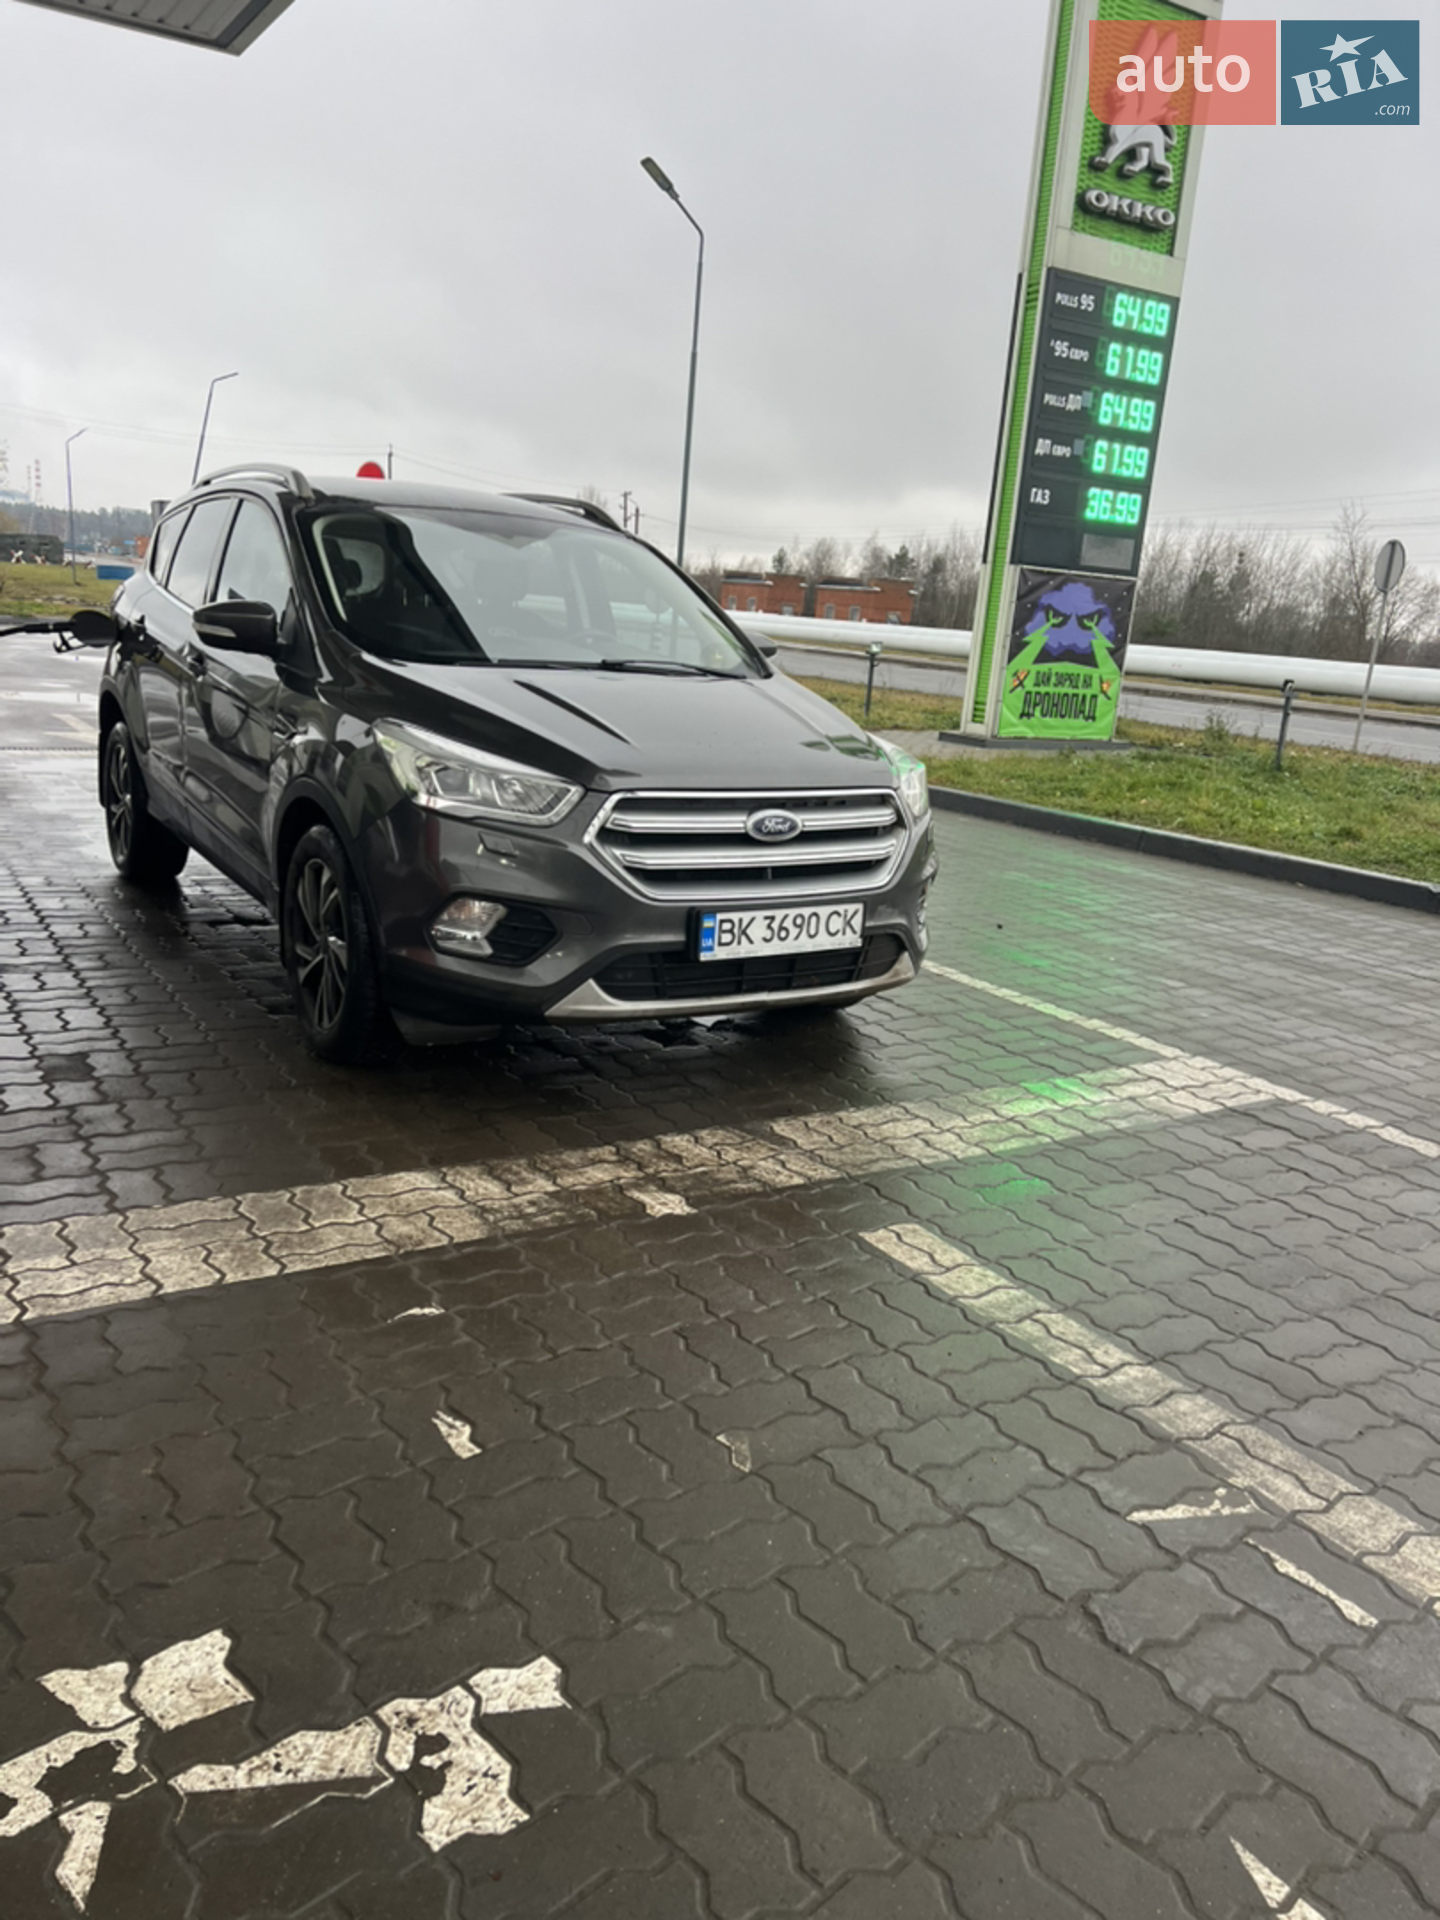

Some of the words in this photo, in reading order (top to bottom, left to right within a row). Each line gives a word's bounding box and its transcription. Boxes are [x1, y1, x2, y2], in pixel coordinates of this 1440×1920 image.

[1083, 188, 1175, 228] OKKO
[1079, 293, 1095, 312] 95
[1112, 292, 1170, 338] 64.99
[1105, 341, 1163, 385] 61.99
[1098, 391, 1156, 433] 64.99
[1034, 438, 1052, 457] ДП
[1091, 439, 1149, 479] 61.99
[1030, 487, 1051, 505] ГАЗ
[1084, 486, 1142, 525] 36.99
[1033, 668, 1053, 687] ДАЙ
[1053, 671, 1080, 690] ЗАРЯД
[1081, 673, 1093, 690] НА
[1019, 691, 1098, 722] ДРОНОПАД
[762, 817, 791, 833] Ford
[717, 916, 756, 947] BK
[762, 911, 821, 943] 3690
